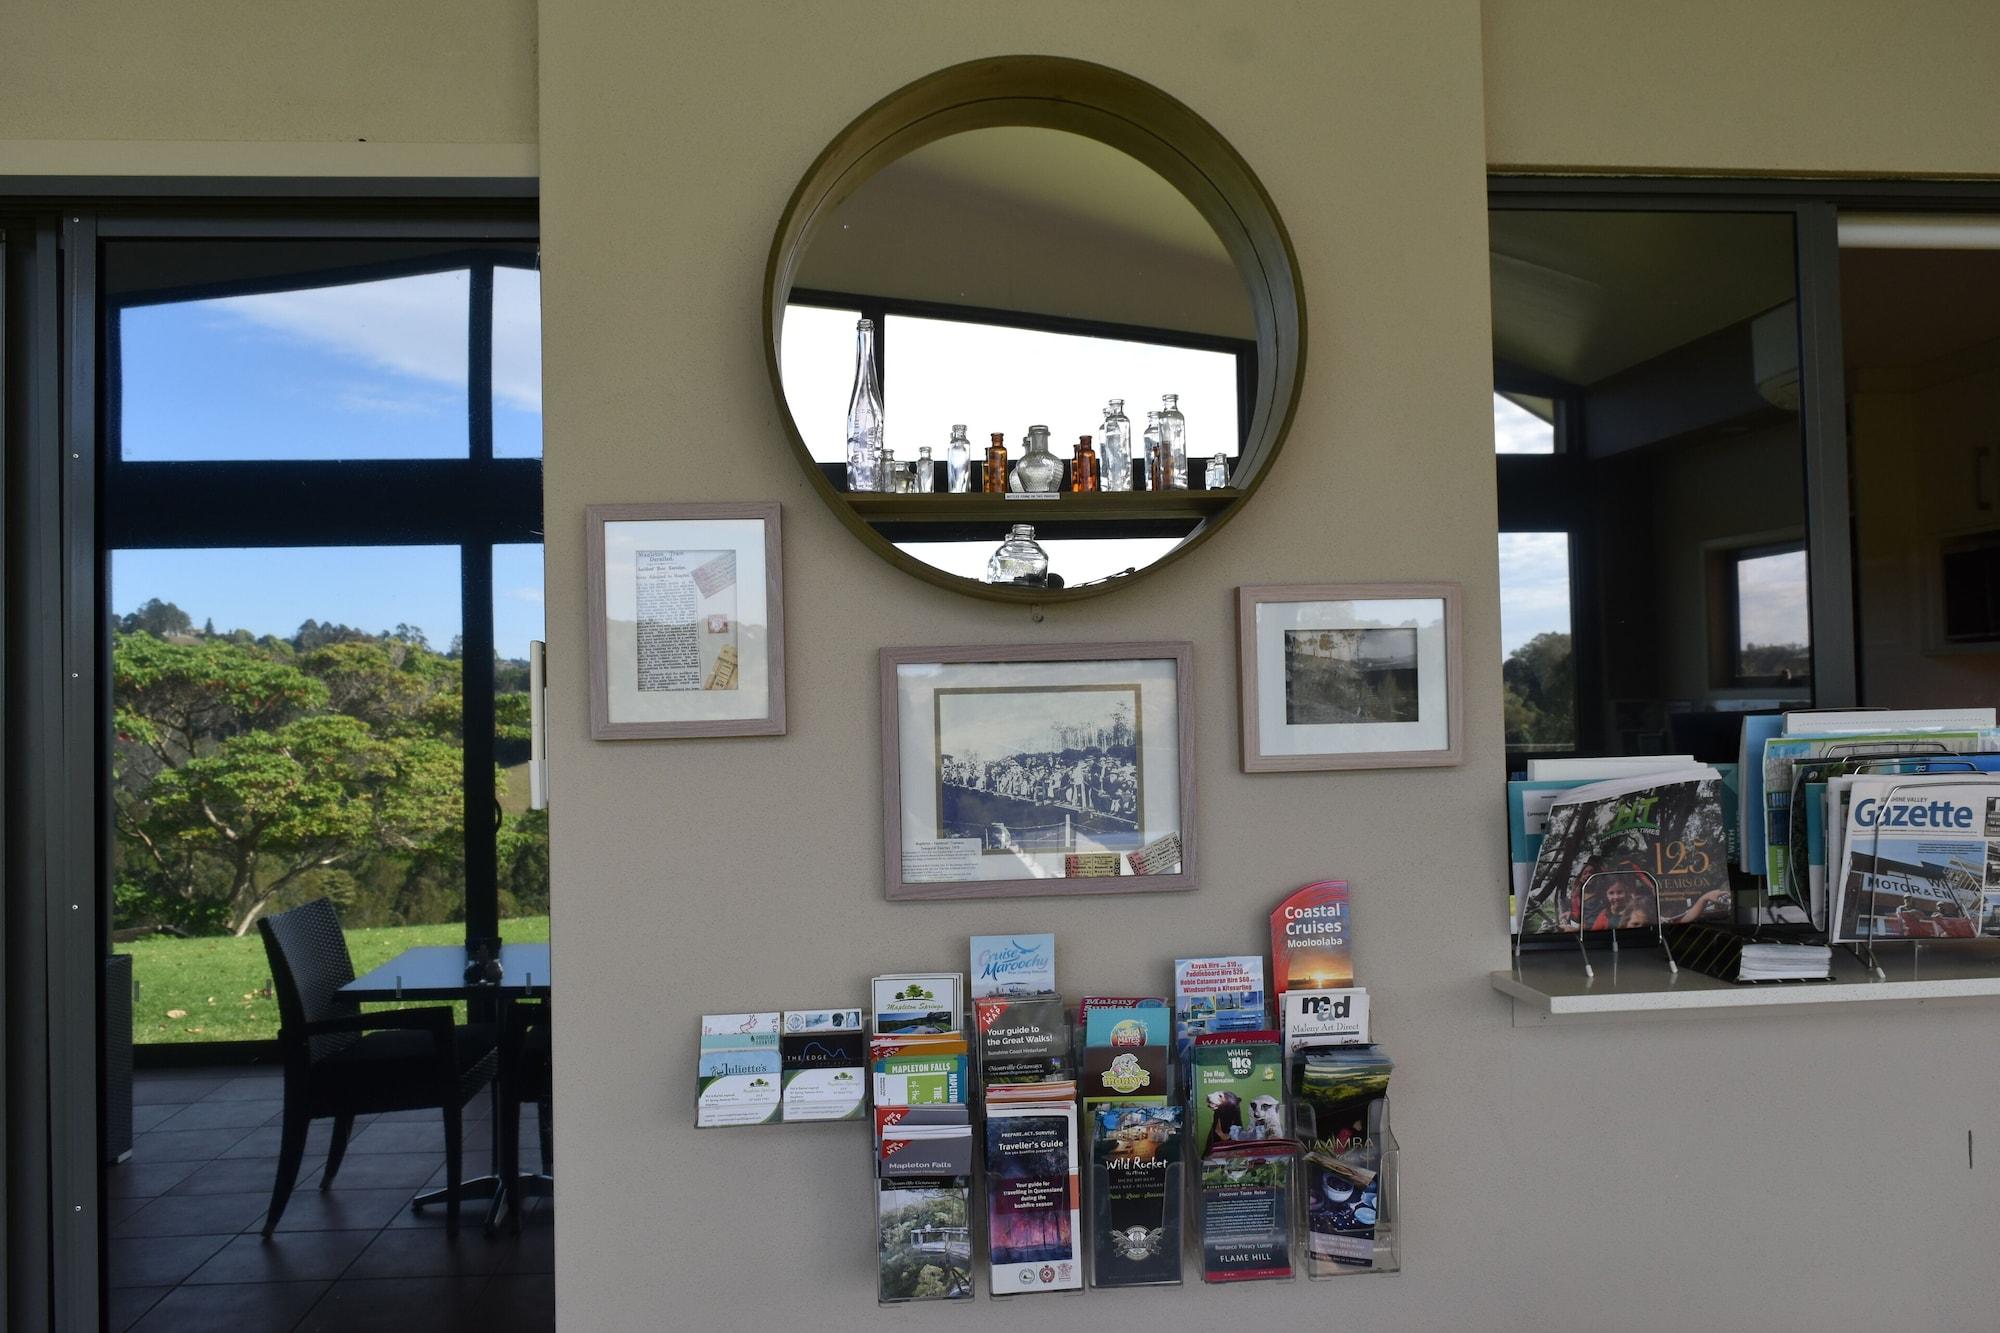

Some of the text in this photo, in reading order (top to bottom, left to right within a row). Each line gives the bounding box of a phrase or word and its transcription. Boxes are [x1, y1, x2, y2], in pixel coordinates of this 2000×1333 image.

[1855, 798, 1973, 828] Gazette
[1653, 838, 1711, 875] 125
[1868, 877, 1921, 896] MOTOR
[1284, 903, 1341, 919] Coastal
[1285, 921, 1342, 936] Cruises
[1287, 936, 1343, 948] Mooloolaba
[979, 947, 1018, 967] Cruise
[980, 953, 1049, 980] Maroochy
[887, 1002, 944, 1012] Mapleton Springs
[1007, 1027, 1029, 1036] guide
[1292, 1022, 1359, 1034] Maleny Art Direct
[987, 1034, 1053, 1046] the Great Walks!
[892, 1062, 951, 1074] MAPLETON FALLS
[1232, 1057, 1252, 1069] HQ
[934, 1086, 942, 1099] THE
[999, 1140, 1064, 1151] Traveller's Guide
[1106, 1156, 1168, 1170] Wild Rocket
[1257, 1242, 1273, 1250] Luxury
[1220, 1253, 1272, 1263] FLAME HILL
